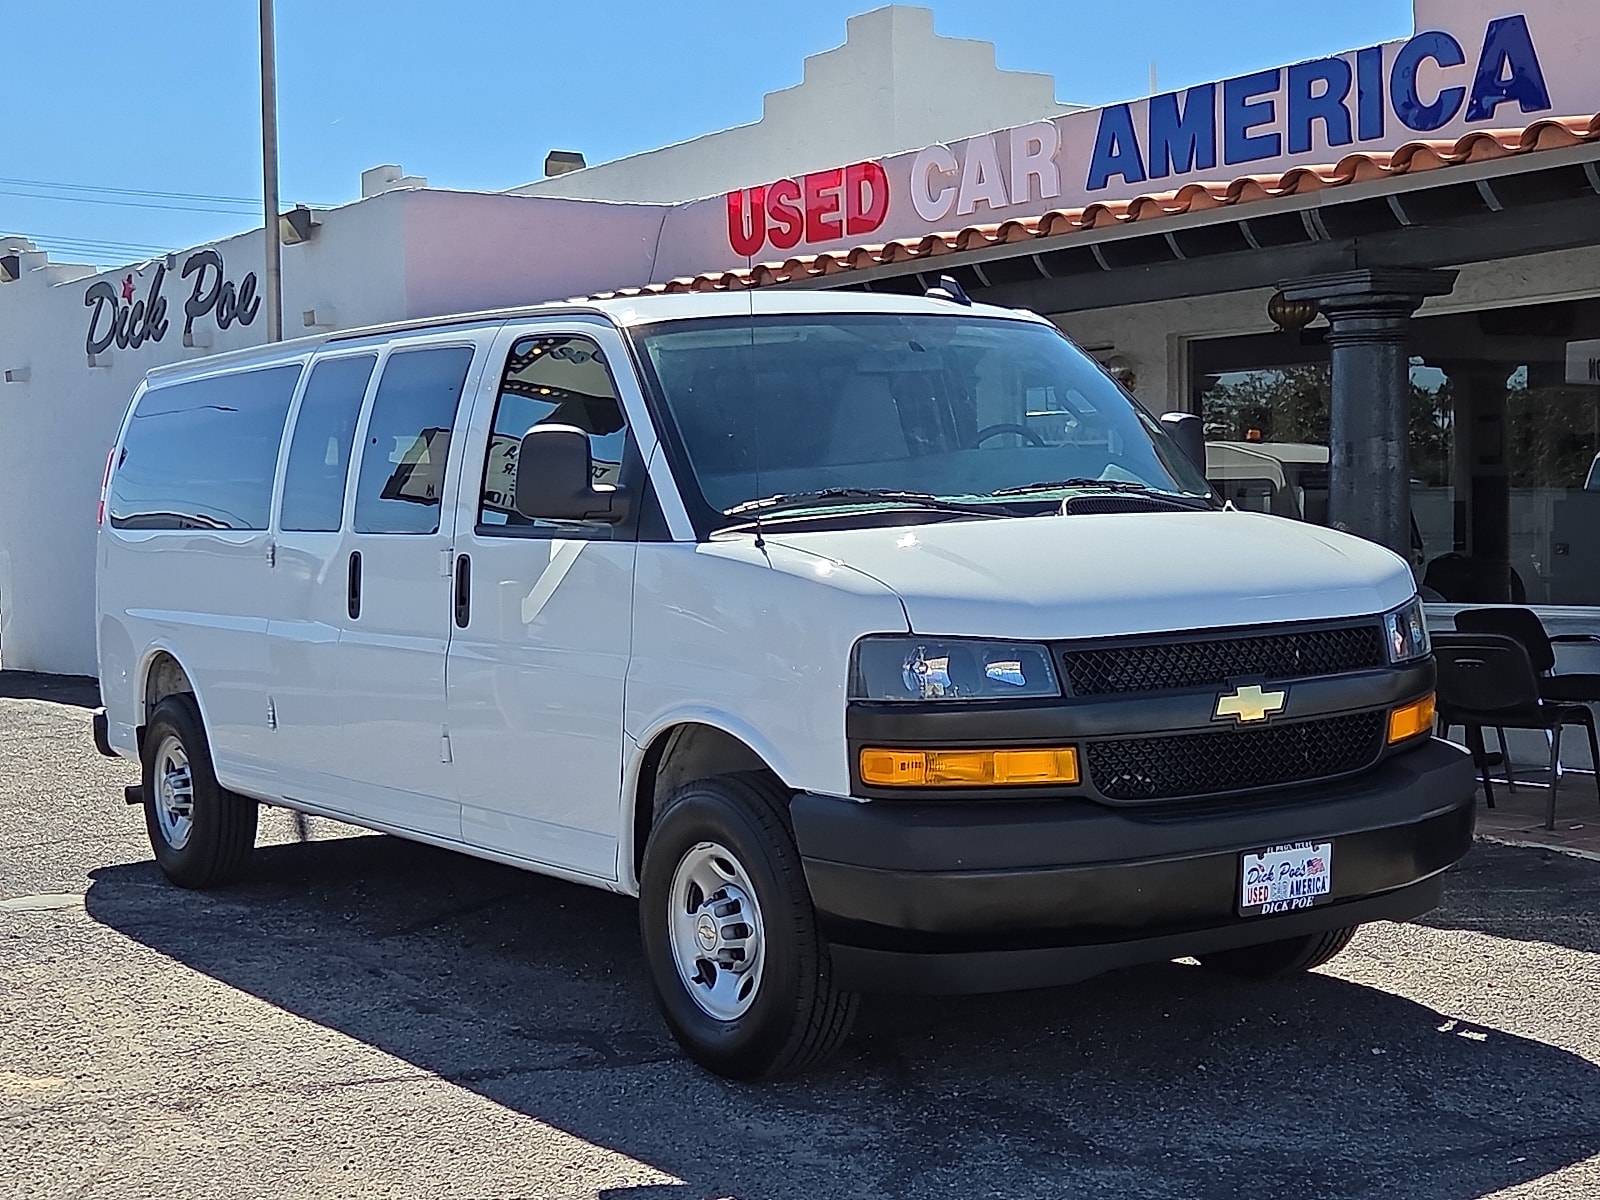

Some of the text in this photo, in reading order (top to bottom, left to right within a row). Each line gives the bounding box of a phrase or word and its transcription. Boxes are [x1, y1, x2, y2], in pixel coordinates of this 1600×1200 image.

[726, 14, 1552, 257] USED CAR AMERICA
[84, 250, 261, 354] Dick Poe
[1247, 863, 1274, 885] Dick
[1247, 885, 1269, 904] USED
[1289, 876, 1326, 897] AMERICA
[1261, 896, 1314, 914] DICK POE
